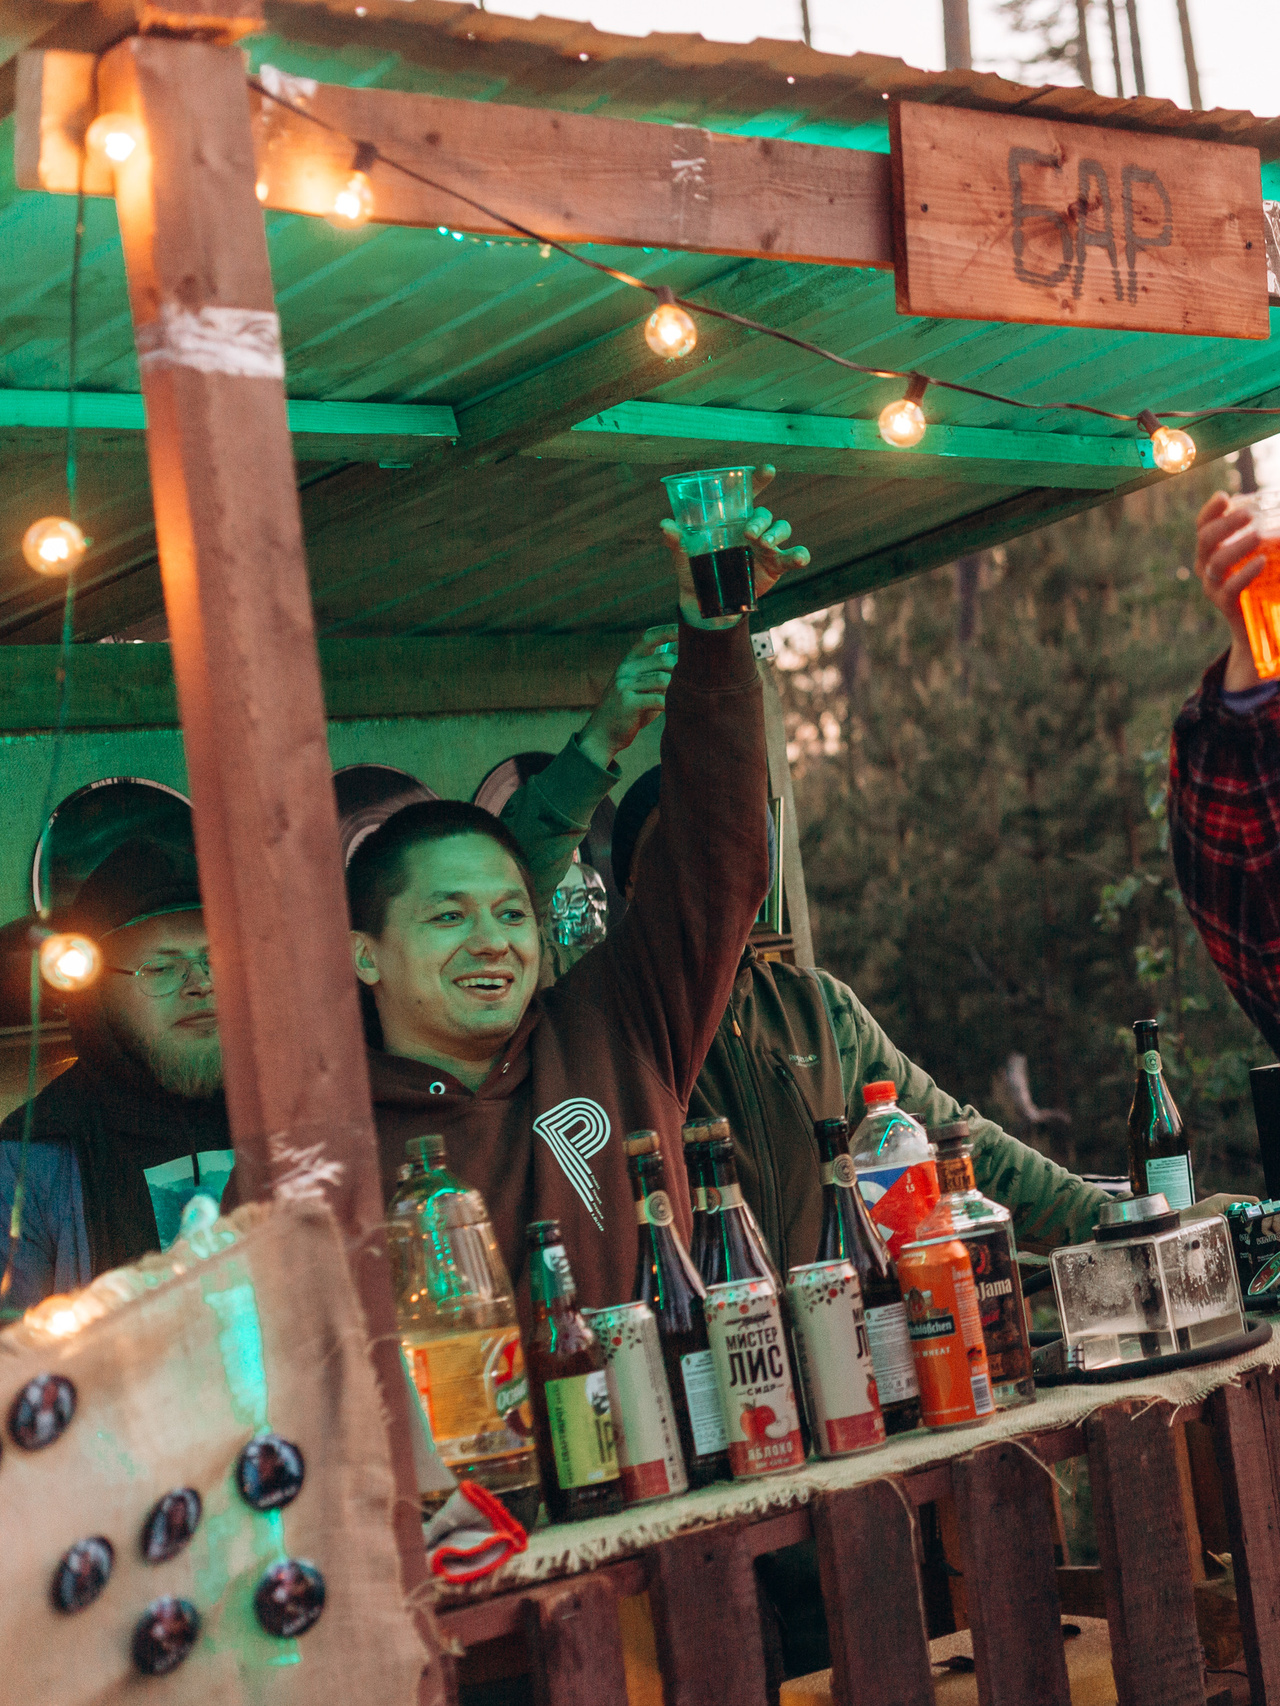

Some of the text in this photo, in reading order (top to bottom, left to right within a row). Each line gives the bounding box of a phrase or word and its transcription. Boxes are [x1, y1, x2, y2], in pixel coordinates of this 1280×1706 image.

[1007, 146, 1174, 307] БАР
[725, 1326, 778, 1352] МИСТЕР
[729, 1344, 784, 1388] ЛИС
[747, 1441, 794, 1462] ЯБЛОКО
